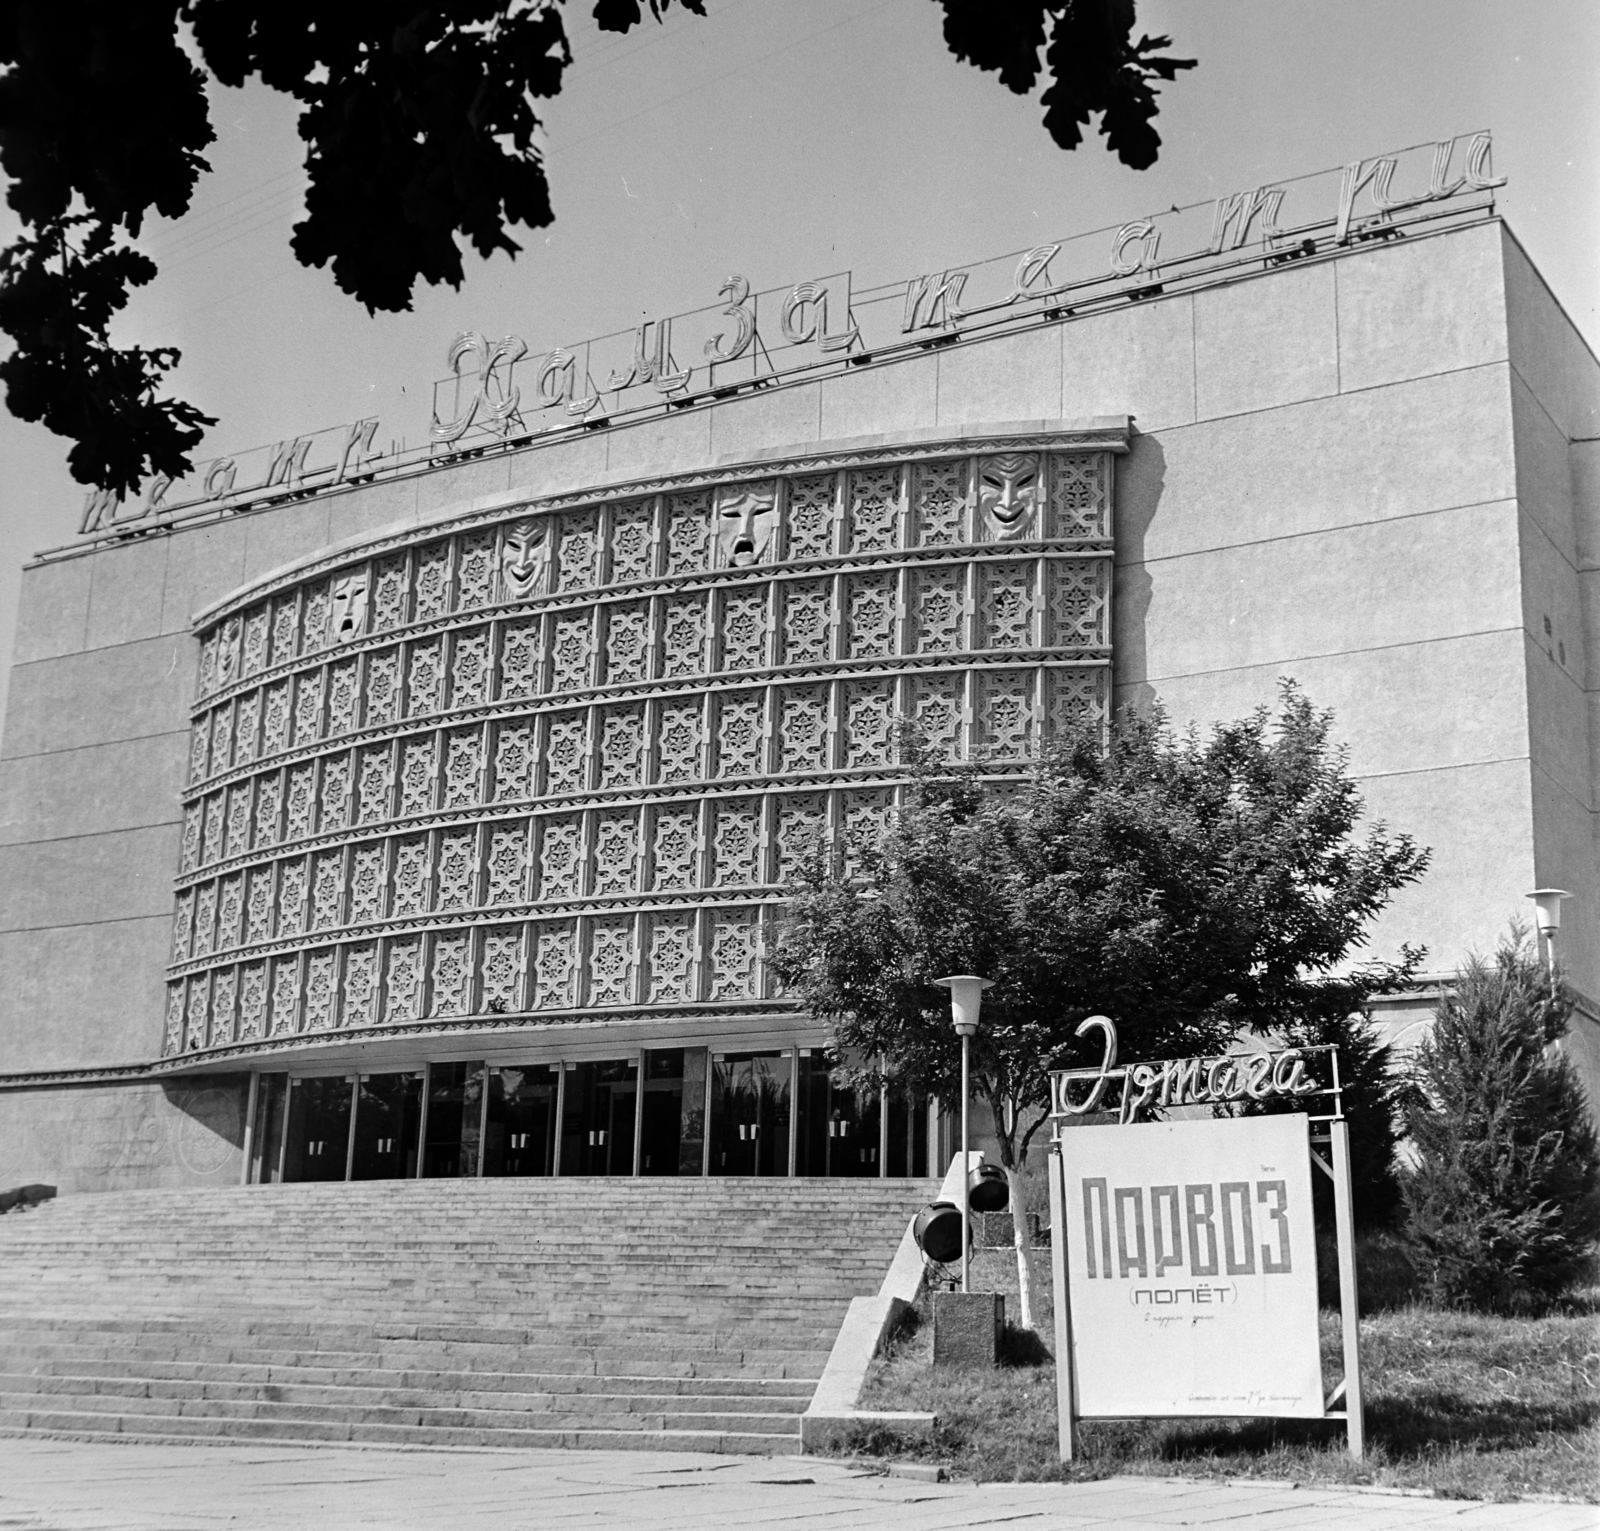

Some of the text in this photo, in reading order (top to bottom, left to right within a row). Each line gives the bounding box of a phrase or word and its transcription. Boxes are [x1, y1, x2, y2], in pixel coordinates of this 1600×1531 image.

[902, 132, 1508, 334] театри
[1059, 1014, 1319, 1124] Эртага
[1081, 1177, 1293, 1279] ПАРВОЗ
[1129, 1281, 1238, 1307] (ПОЛЁТ)
